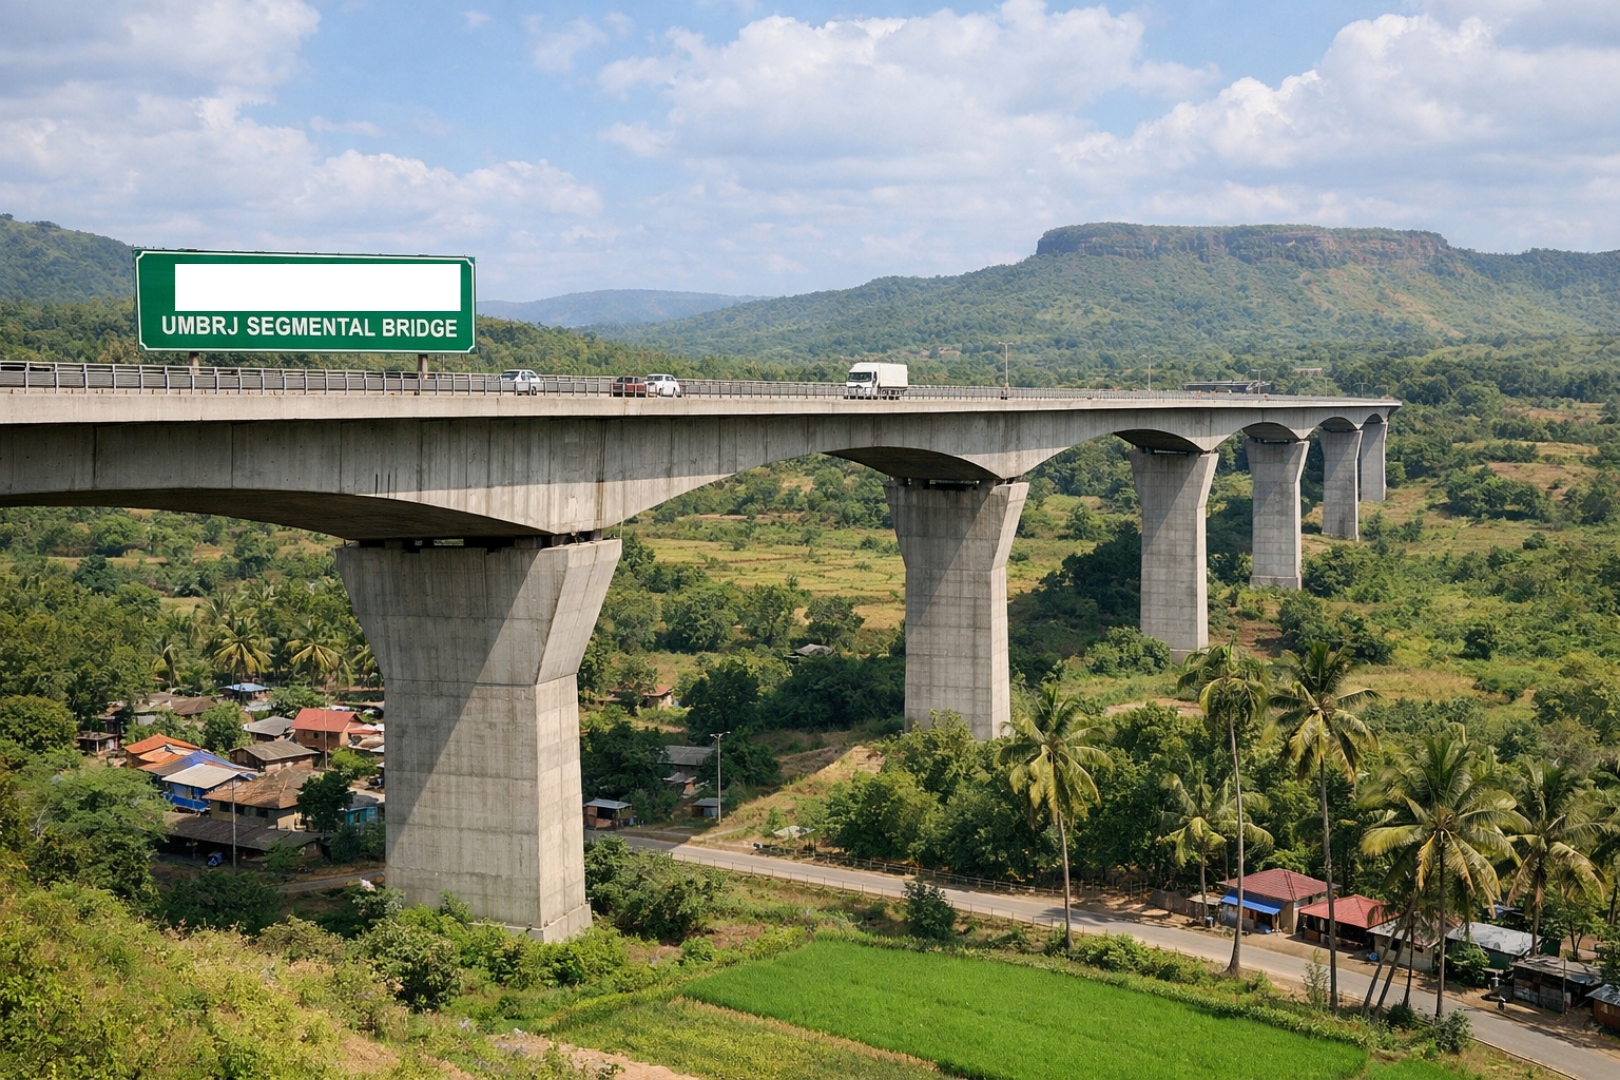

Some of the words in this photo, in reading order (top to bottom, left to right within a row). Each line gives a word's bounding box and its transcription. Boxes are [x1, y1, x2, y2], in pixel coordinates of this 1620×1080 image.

[162, 315, 238, 335] UMBRJ
[246, 316, 376, 337] SEGMENTAL
[382, 318, 458, 338] BRIDGE
